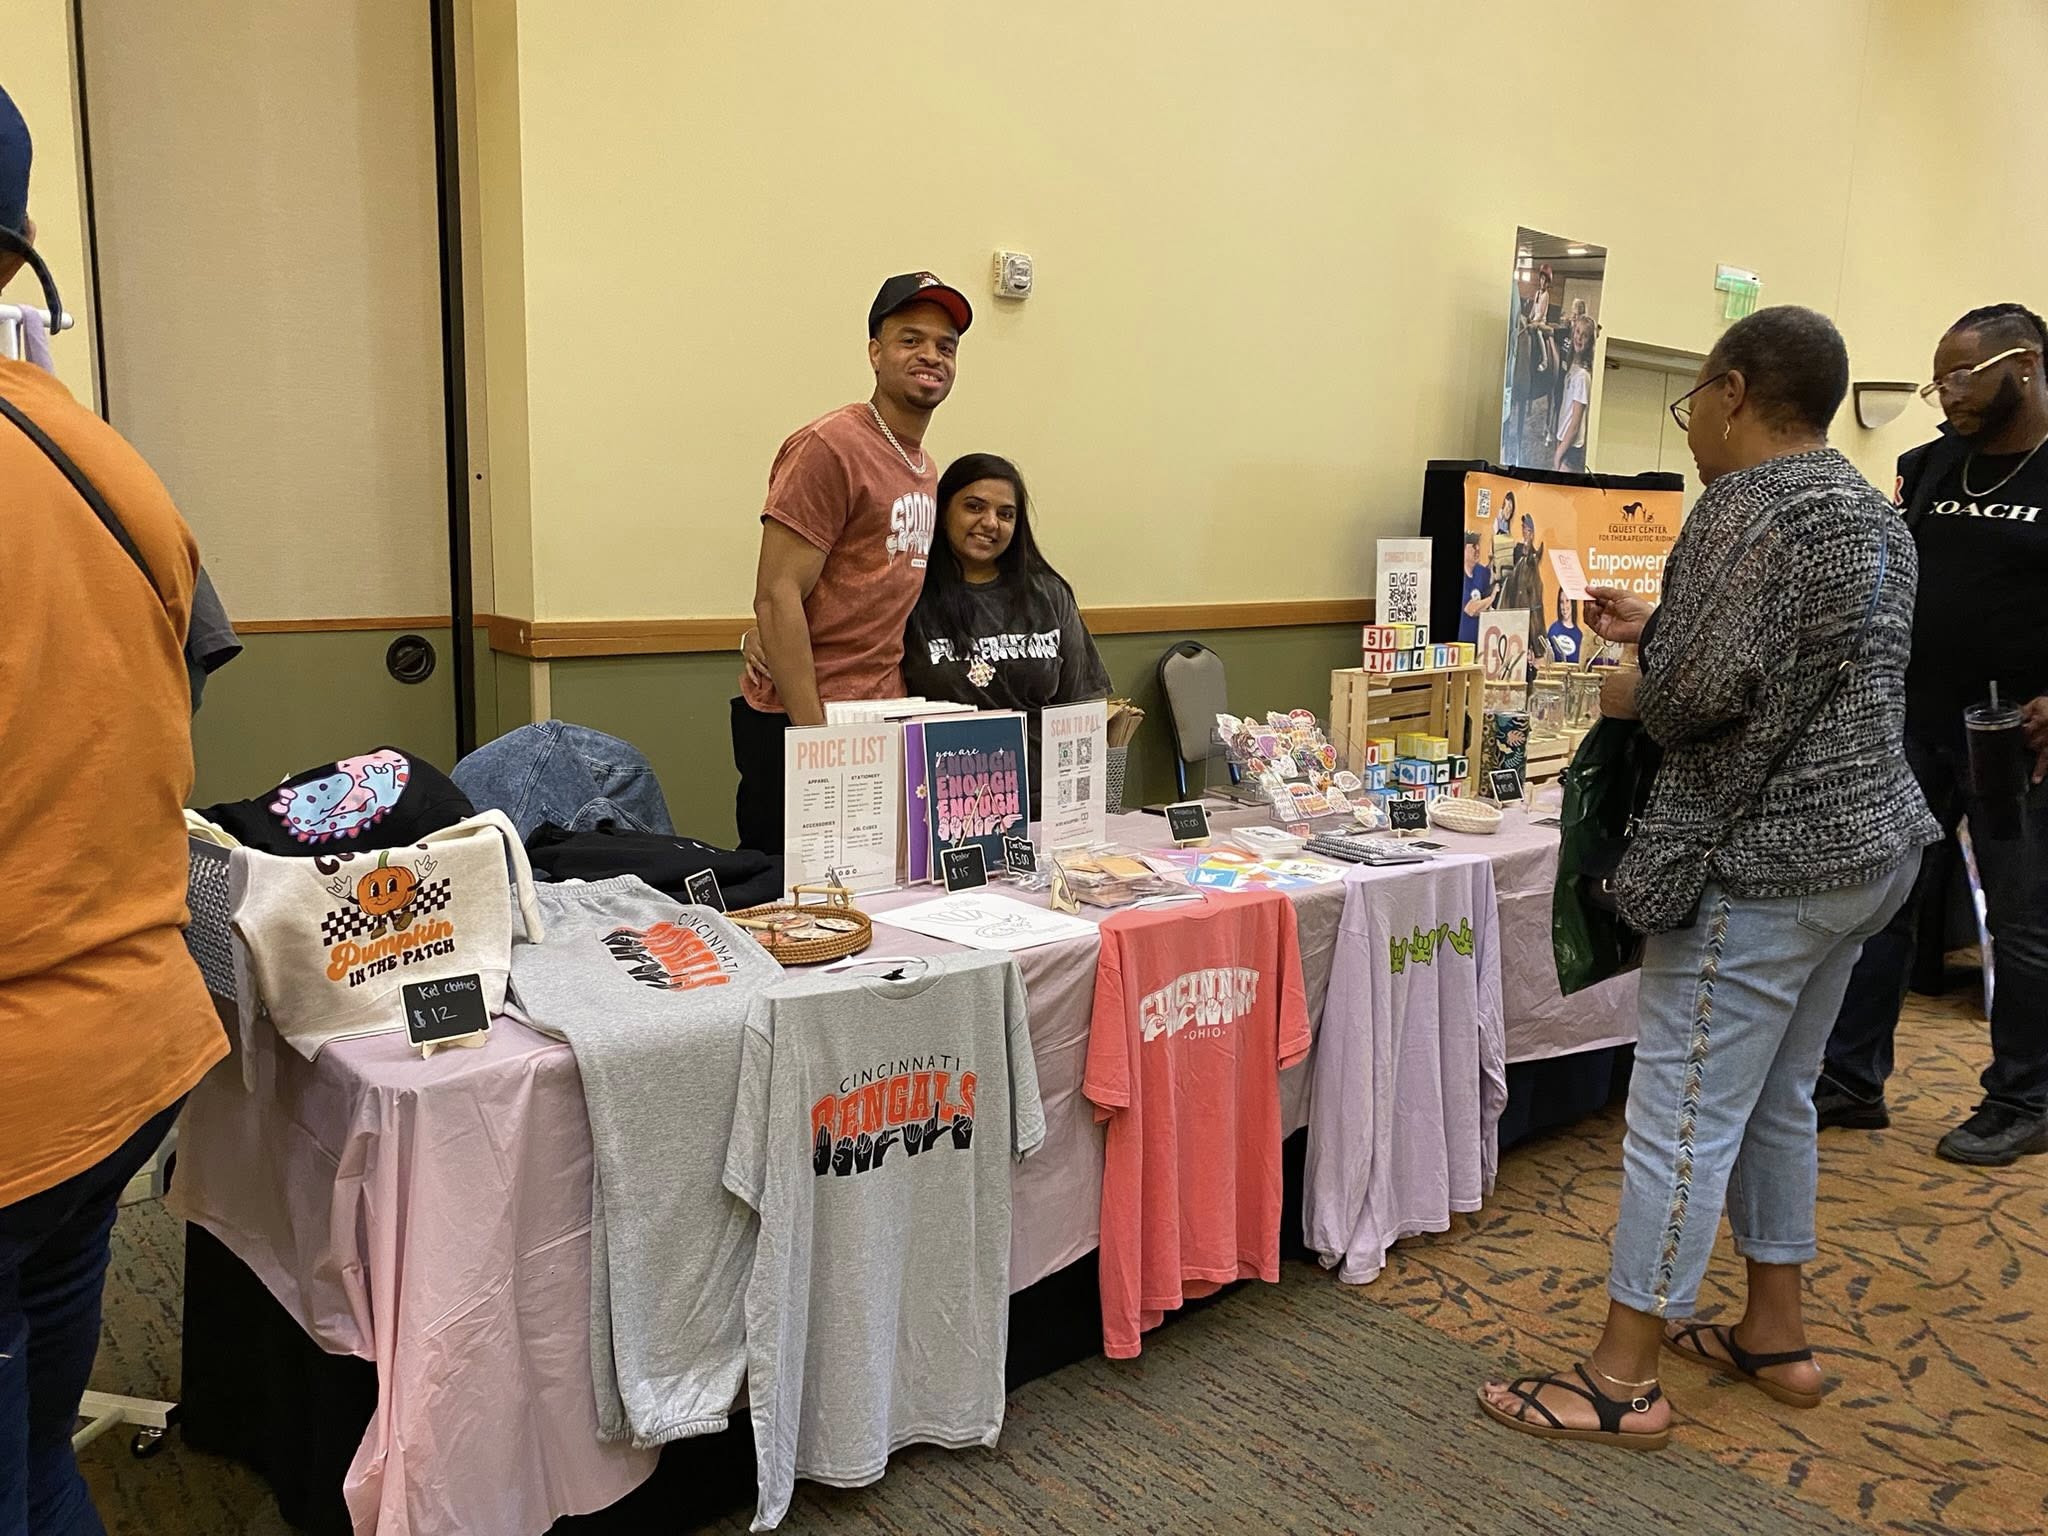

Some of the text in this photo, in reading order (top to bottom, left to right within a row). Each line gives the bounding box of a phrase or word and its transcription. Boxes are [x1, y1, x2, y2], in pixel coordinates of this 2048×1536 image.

[1929, 501, 2042, 523] OACH
[1608, 525, 1668, 534] EQUEST CENTER
[1611, 534, 1654, 542] THERAPEUTIC
[1588, 547, 1667, 575] Empoweri
[1633, 572, 1663, 593] abi
[1367, 631, 1377, 646] 5
[1417, 629, 1425, 645] 8
[1369, 654, 1377, 670] 1
[1415, 653, 1422, 667] 4
[1050, 718, 1072, 737] SCAN
[1074, 716, 1083, 733] TO
[797, 735, 887, 770] PRICE LIST
[936, 748, 979, 767] you are
[936, 750, 1017, 776] ENOUGH
[936, 769, 1018, 799] ENOUGH
[938, 793, 1020, 819] ENOUGH
[326, 918, 454, 982] Pumpkin
[678, 912, 741, 973] CINCINNATI
[349, 937, 456, 988] IN THE PATCH
[418, 983, 440, 1000] Kid
[1140, 966, 1259, 1032] CINCINNTI
[840, 1055, 960, 1093] CINCINNATI
[811, 1071, 977, 1150] BENGALS
